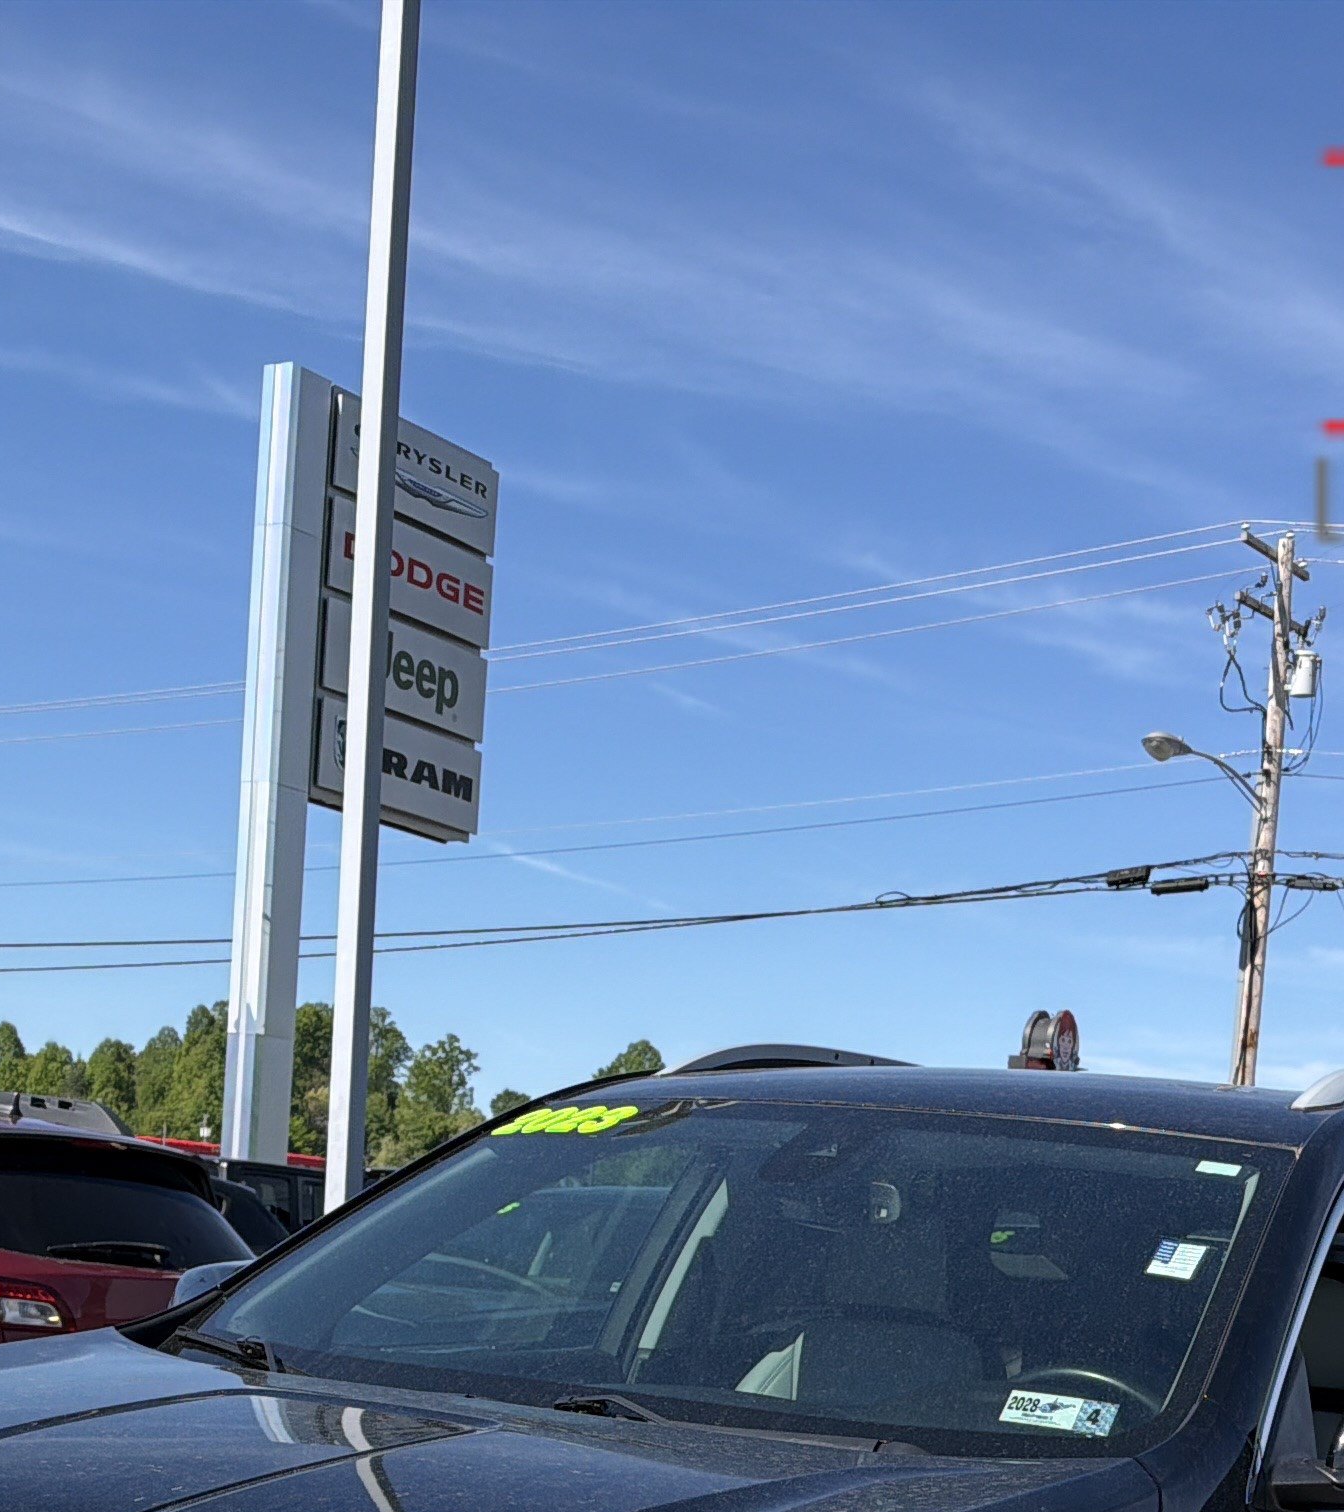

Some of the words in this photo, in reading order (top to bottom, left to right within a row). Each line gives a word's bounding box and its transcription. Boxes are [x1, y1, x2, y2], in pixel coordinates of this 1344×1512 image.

[382, 747, 473, 803] RAM
[1007, 1396, 1041, 1413] 2028
[1086, 1409, 1102, 1425] 4
